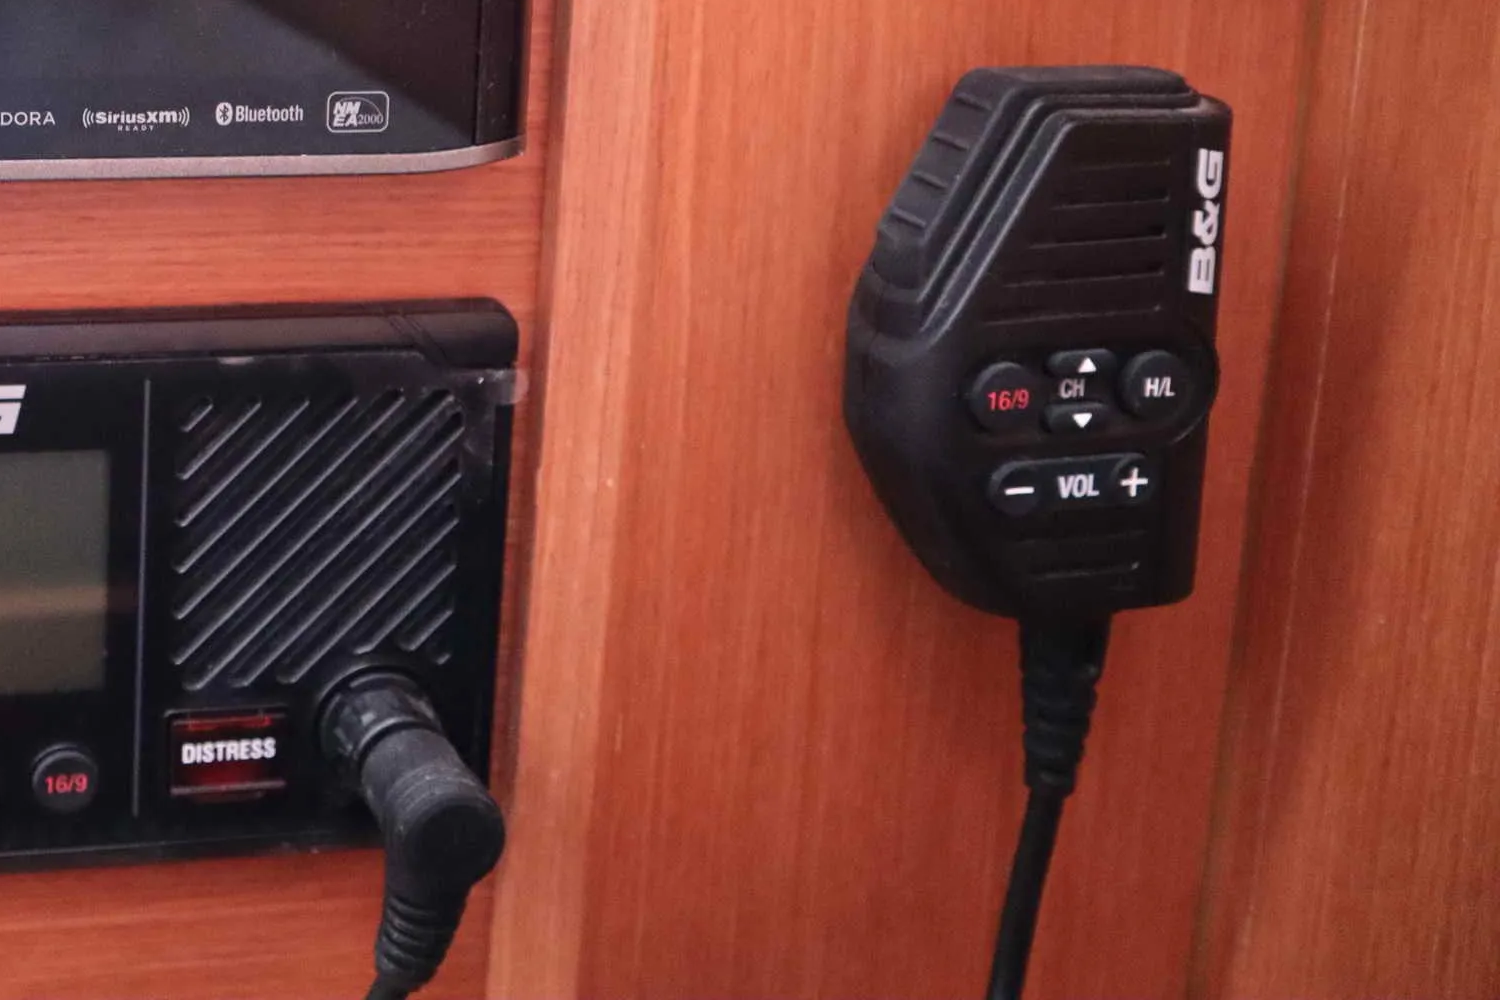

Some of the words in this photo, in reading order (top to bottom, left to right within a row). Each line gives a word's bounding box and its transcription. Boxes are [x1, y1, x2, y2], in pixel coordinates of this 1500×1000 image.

[235, 104, 304, 123] Bluetooth
[1187, 147, 1224, 295] B&G
[1059, 378, 1085, 399] CH
[1143, 377, 1176, 398] H/L
[987, 389, 1031, 411] 16/9
[1057, 474, 1100, 499] VOL
[181, 737, 277, 765] DISTRESS
[44, 773, 88, 795] 16/9
